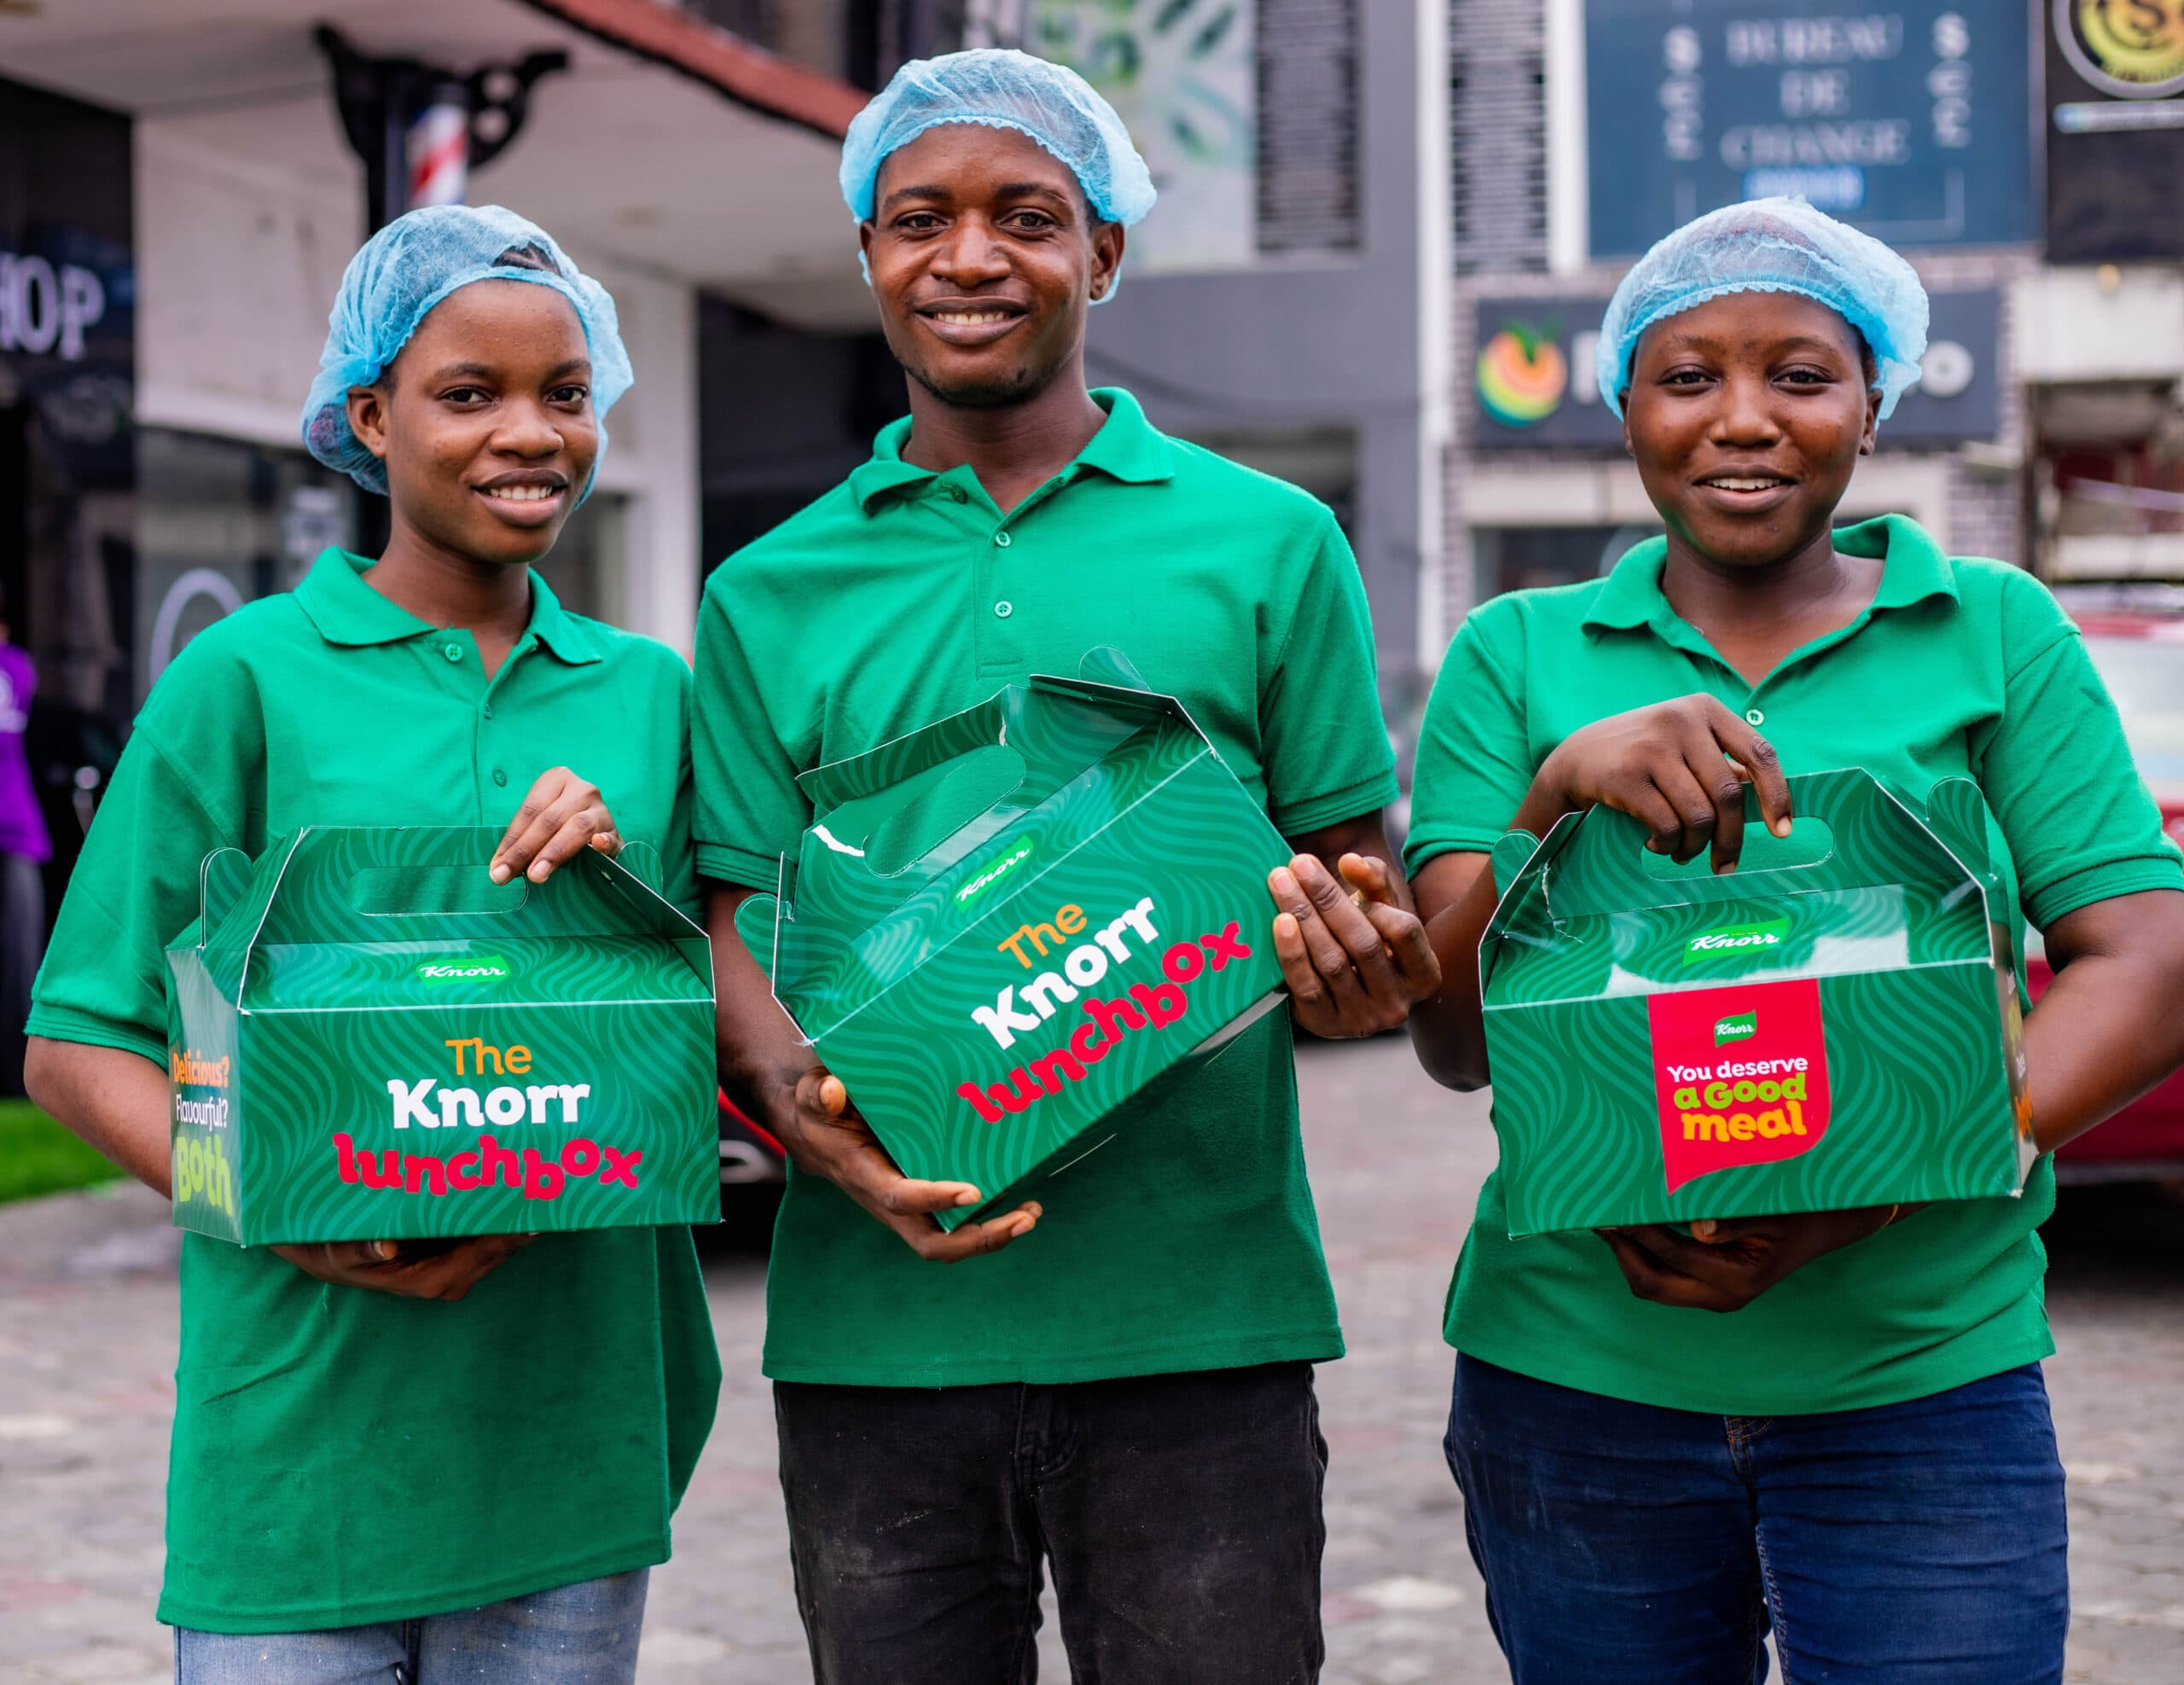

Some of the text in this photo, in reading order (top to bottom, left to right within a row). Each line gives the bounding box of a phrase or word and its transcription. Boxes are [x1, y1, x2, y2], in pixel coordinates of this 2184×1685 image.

[1780, 69, 1850, 117] DE
[1721, 120, 1910, 168] CHANGE
[956, 848, 1031, 902] Knorr
[997, 904, 1087, 969] The
[1690, 933, 1780, 950] Knorr
[419, 965, 505, 978] Knorr
[971, 896, 1160, 1050] Knorr
[956, 921, 1252, 1124] lunchbox
[1716, 1023, 1754, 1036] Knorr
[173, 1049, 230, 1088] Delicious?
[444, 1037, 532, 1076] The
[1666, 1056, 1809, 1083] You deserve
[176, 1093, 229, 1132] Flavourful?
[386, 1078, 591, 1129] Knorr
[1673, 1072, 1808, 1110] a Good
[1680, 1100, 1808, 1142] meal
[176, 1133, 233, 1217] Both
[332, 1132, 643, 1200] lunchbox
